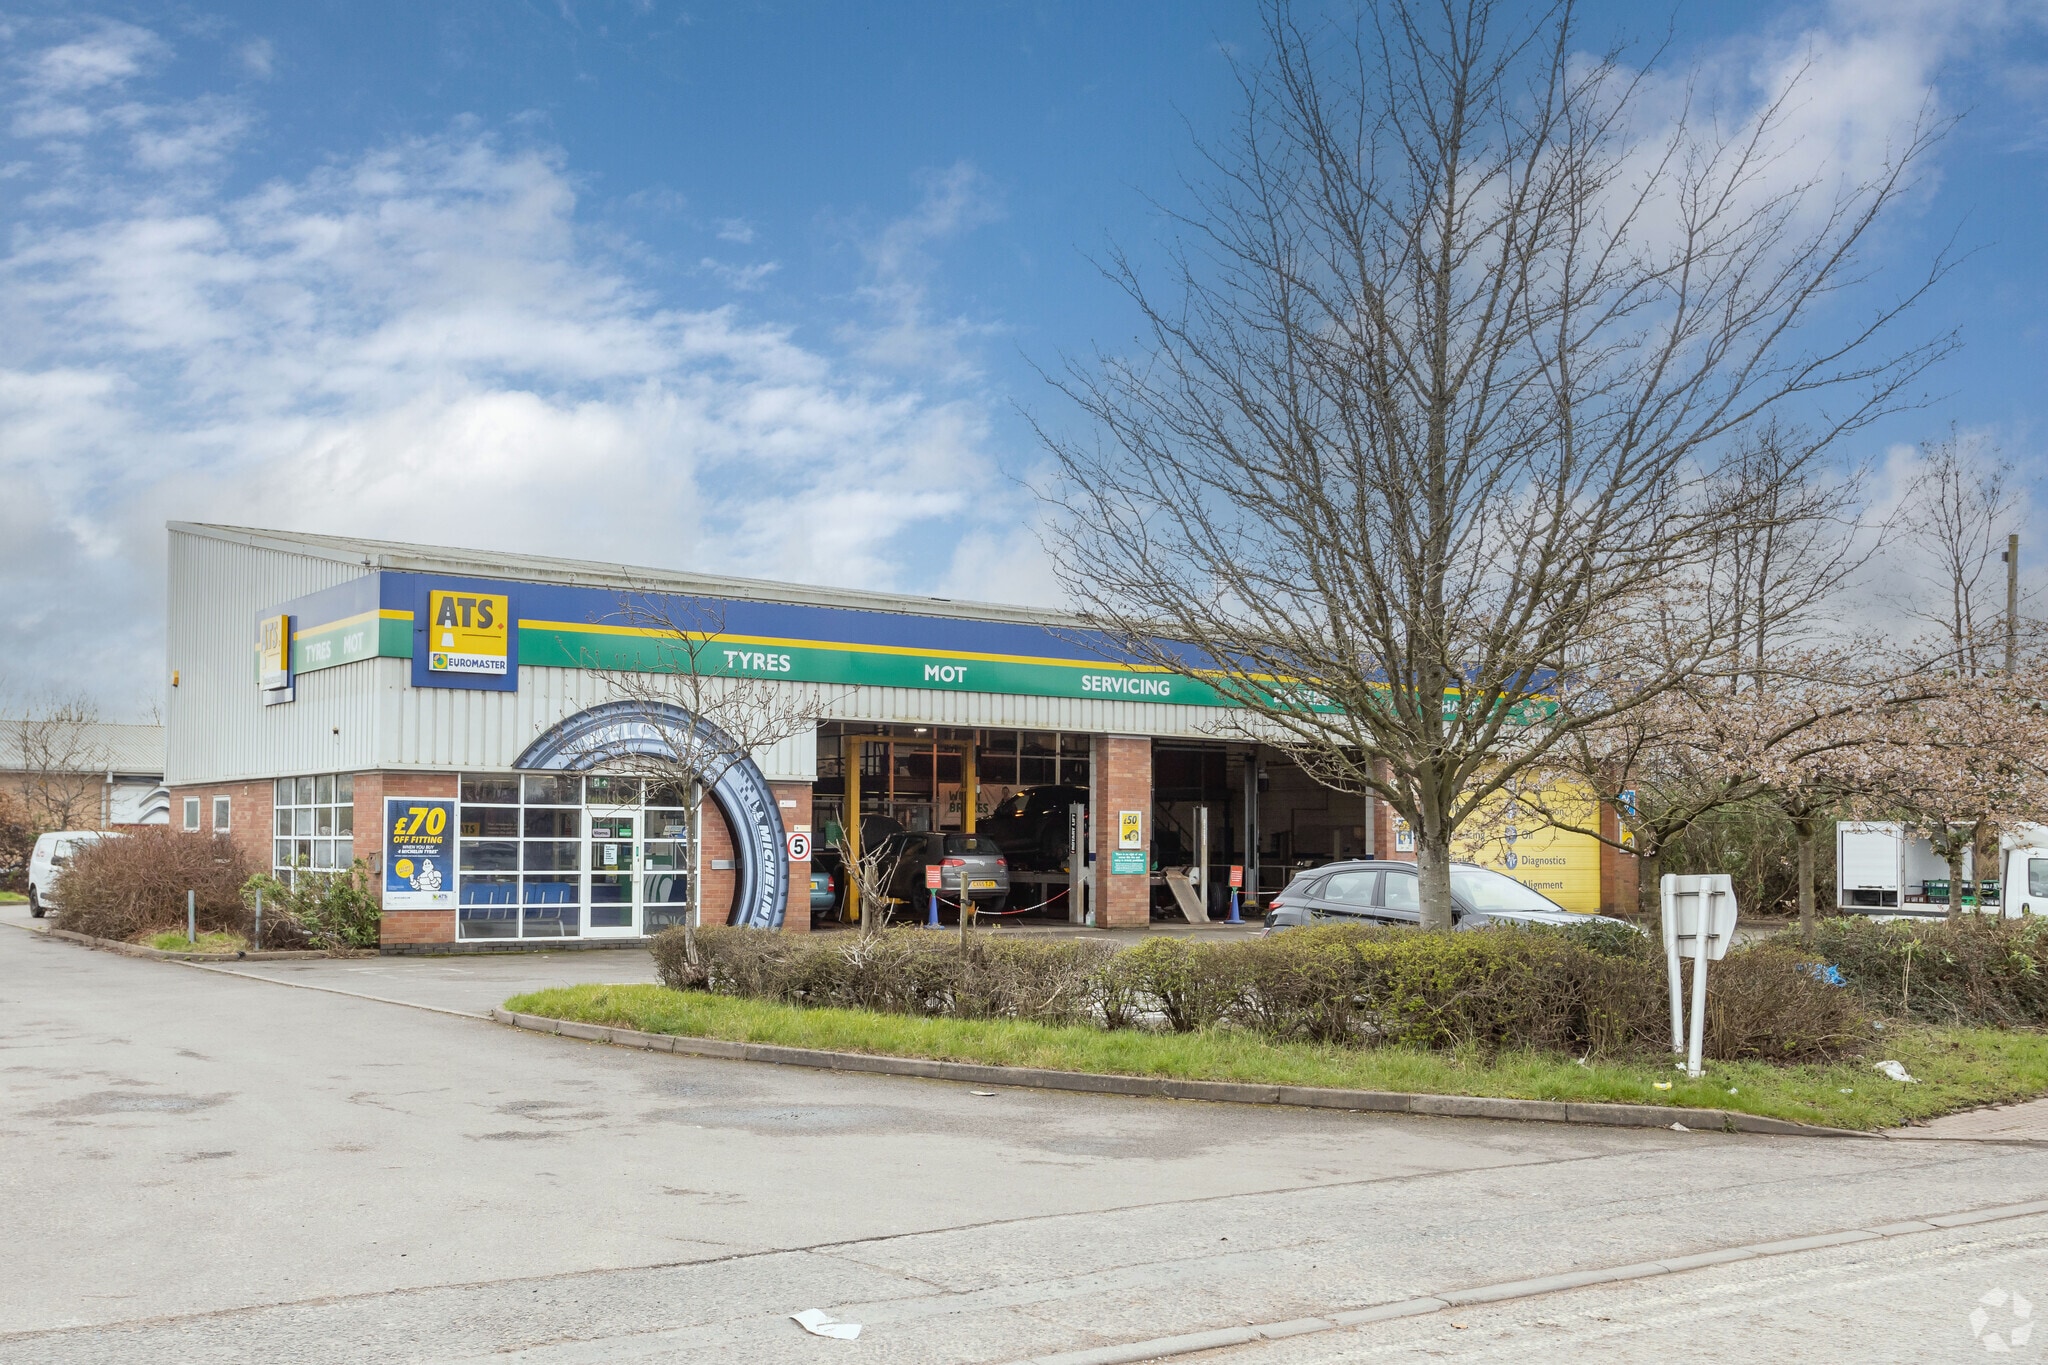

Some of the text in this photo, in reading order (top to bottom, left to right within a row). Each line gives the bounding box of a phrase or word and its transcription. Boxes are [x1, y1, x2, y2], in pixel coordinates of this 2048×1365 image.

[436, 596, 494, 629] ATS
[305, 632, 364, 662] TYRES MOT
[448, 658, 506, 669] EUROMASTER
[723, 650, 791, 672] TYRES
[924, 664, 968, 683] MOT
[1081, 674, 1171, 696] SERVICING
[393, 806, 447, 836] £70
[393, 836, 443, 844] OFF FITTING
[1522, 830, 1534, 840] Oil
[793, 839, 804, 854] 5
[1522, 856, 1566, 867] Diagnostics
[759, 825, 776, 920] MICHELIN
[1522, 880, 1564, 890] Alignment
